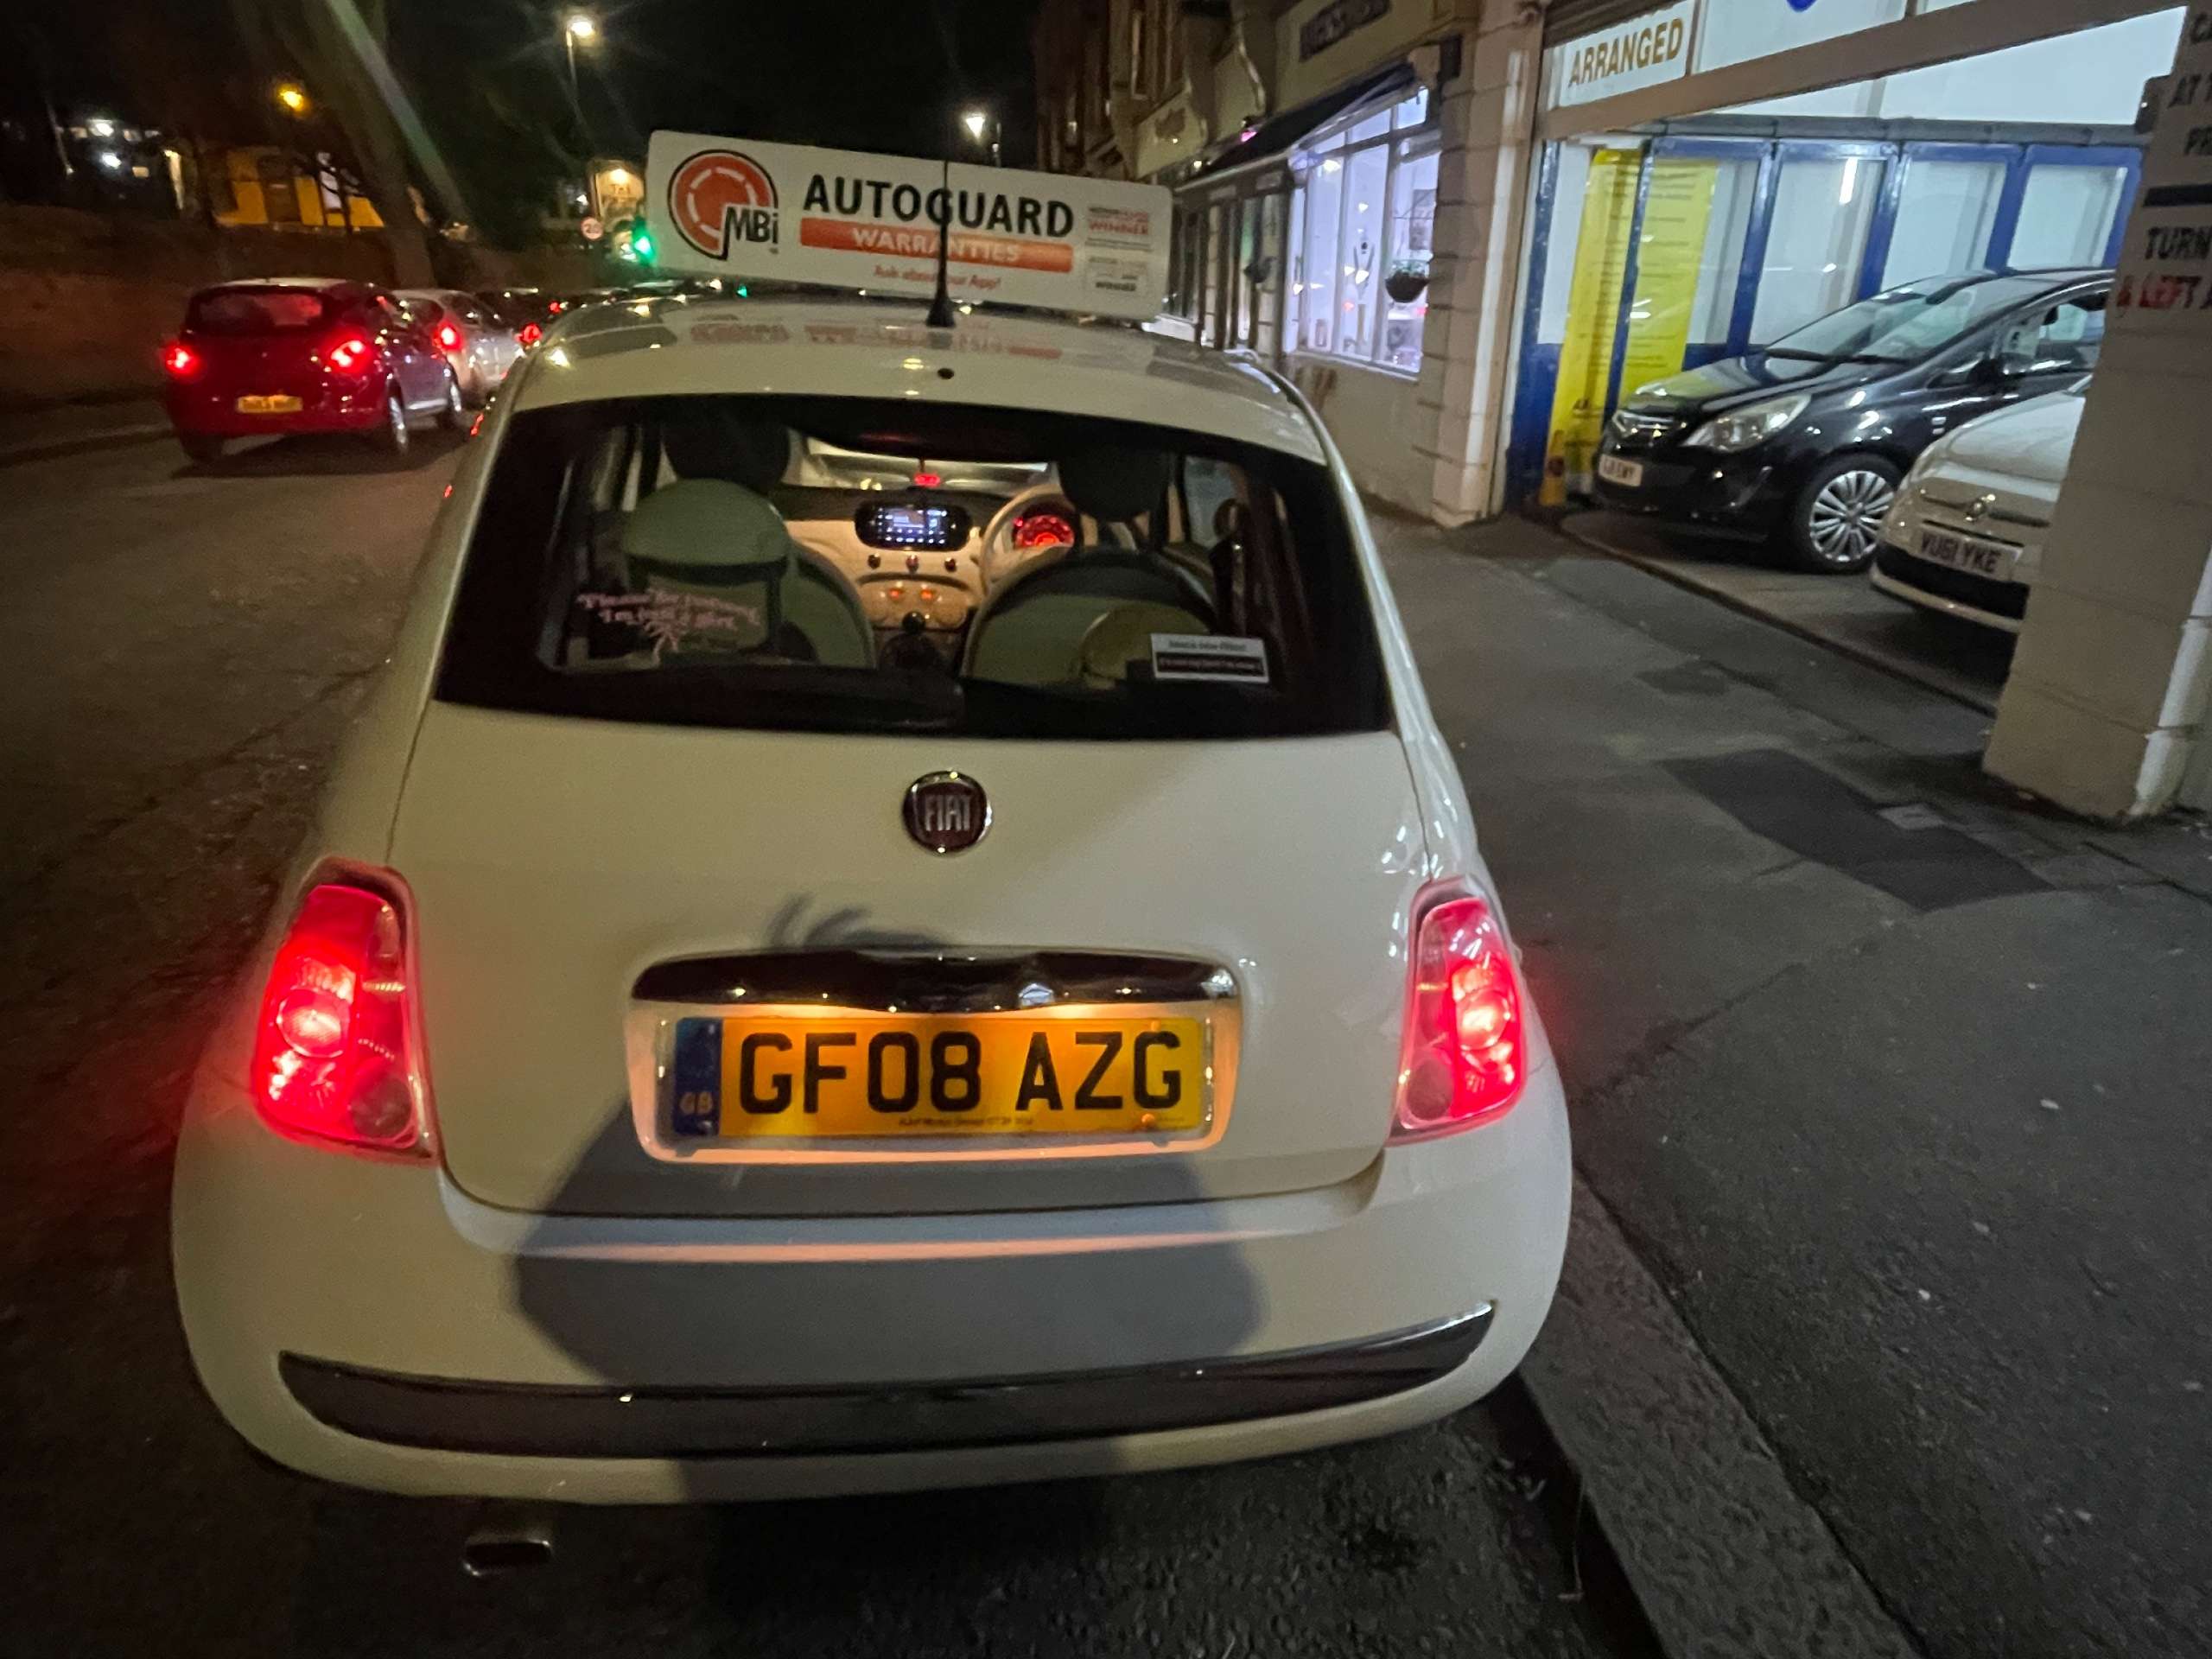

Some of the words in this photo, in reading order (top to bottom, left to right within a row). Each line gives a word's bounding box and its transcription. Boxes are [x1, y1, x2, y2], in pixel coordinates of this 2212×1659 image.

[1567, 18, 1683, 87] ARRANGED
[803, 174, 1074, 238] AUTOGUARD
[851, 226, 1020, 263] WARRANTIES
[925, 794, 971, 831] FIAT
[738, 1031, 982, 1115] GF08
[1014, 1030, 1181, 1112] AZG
